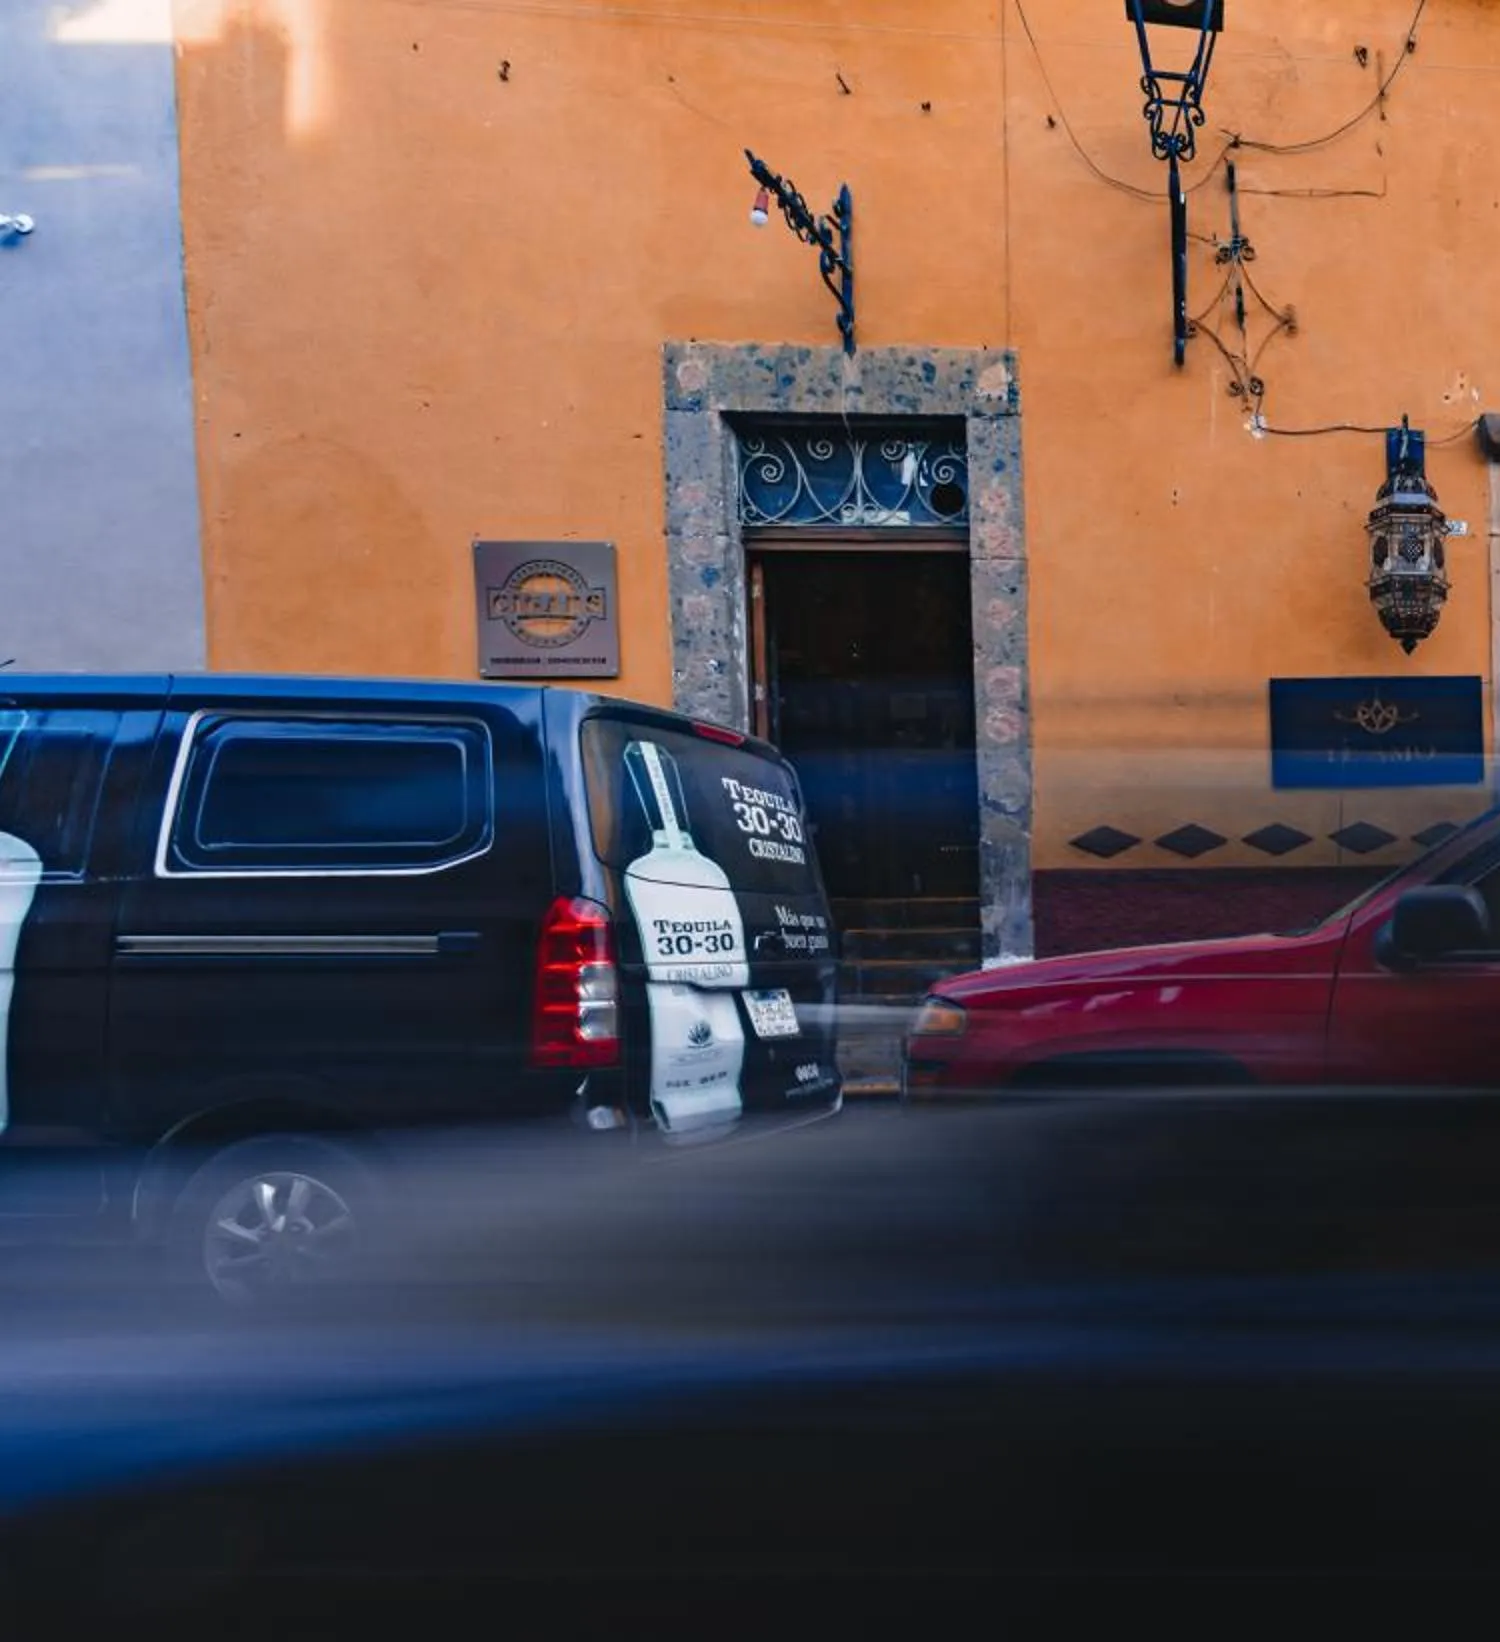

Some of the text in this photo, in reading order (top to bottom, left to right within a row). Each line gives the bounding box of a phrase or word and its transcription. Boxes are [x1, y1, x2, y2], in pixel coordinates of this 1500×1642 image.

[721, 777, 797, 816] TEQUILA
[733, 801, 803, 843] 30-30
[653, 919, 732, 934] TEQUILA
[657, 933, 734, 956] 30-30
